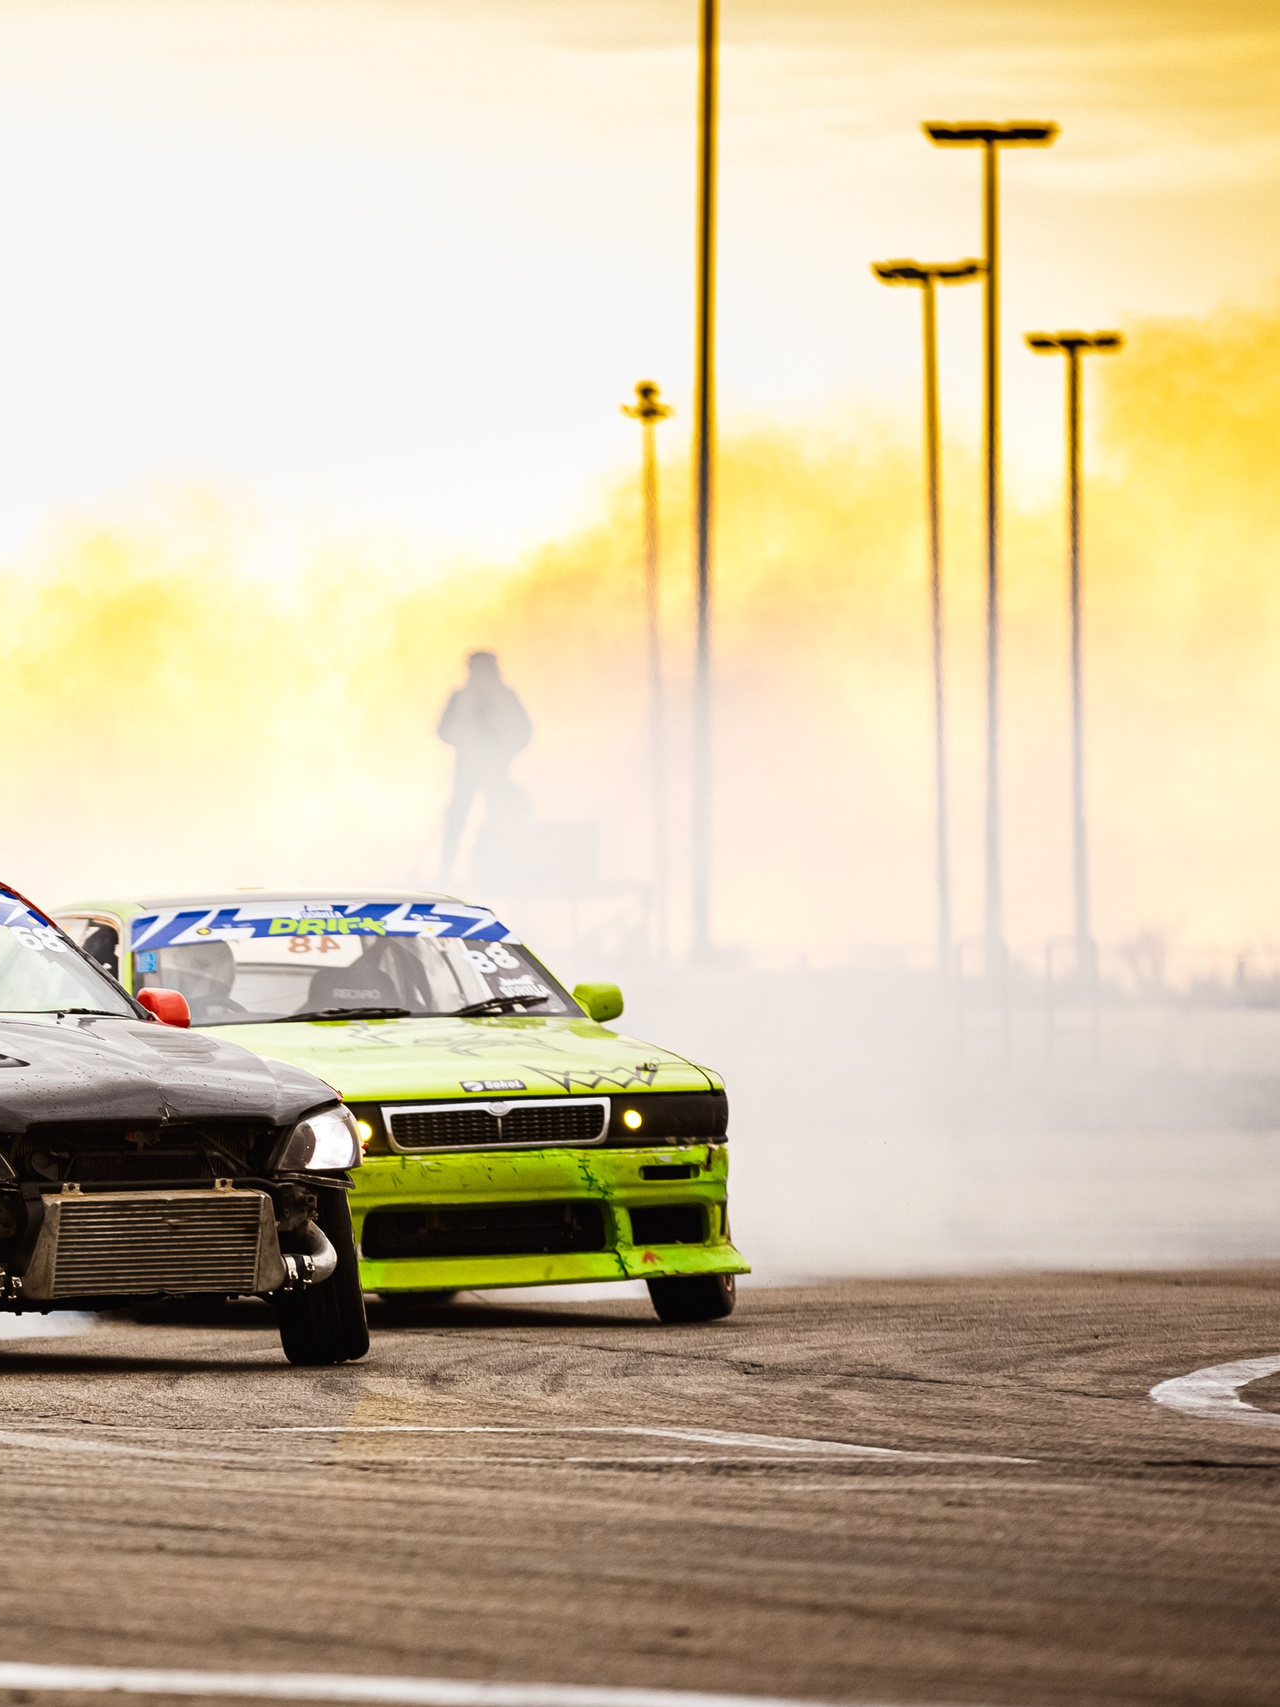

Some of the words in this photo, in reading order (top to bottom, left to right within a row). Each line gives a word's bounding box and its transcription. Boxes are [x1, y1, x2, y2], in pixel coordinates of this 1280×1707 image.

[9, 926, 68, 953] 68
[268, 917, 387, 935] DRIFT
[463, 945, 520, 974] 88
